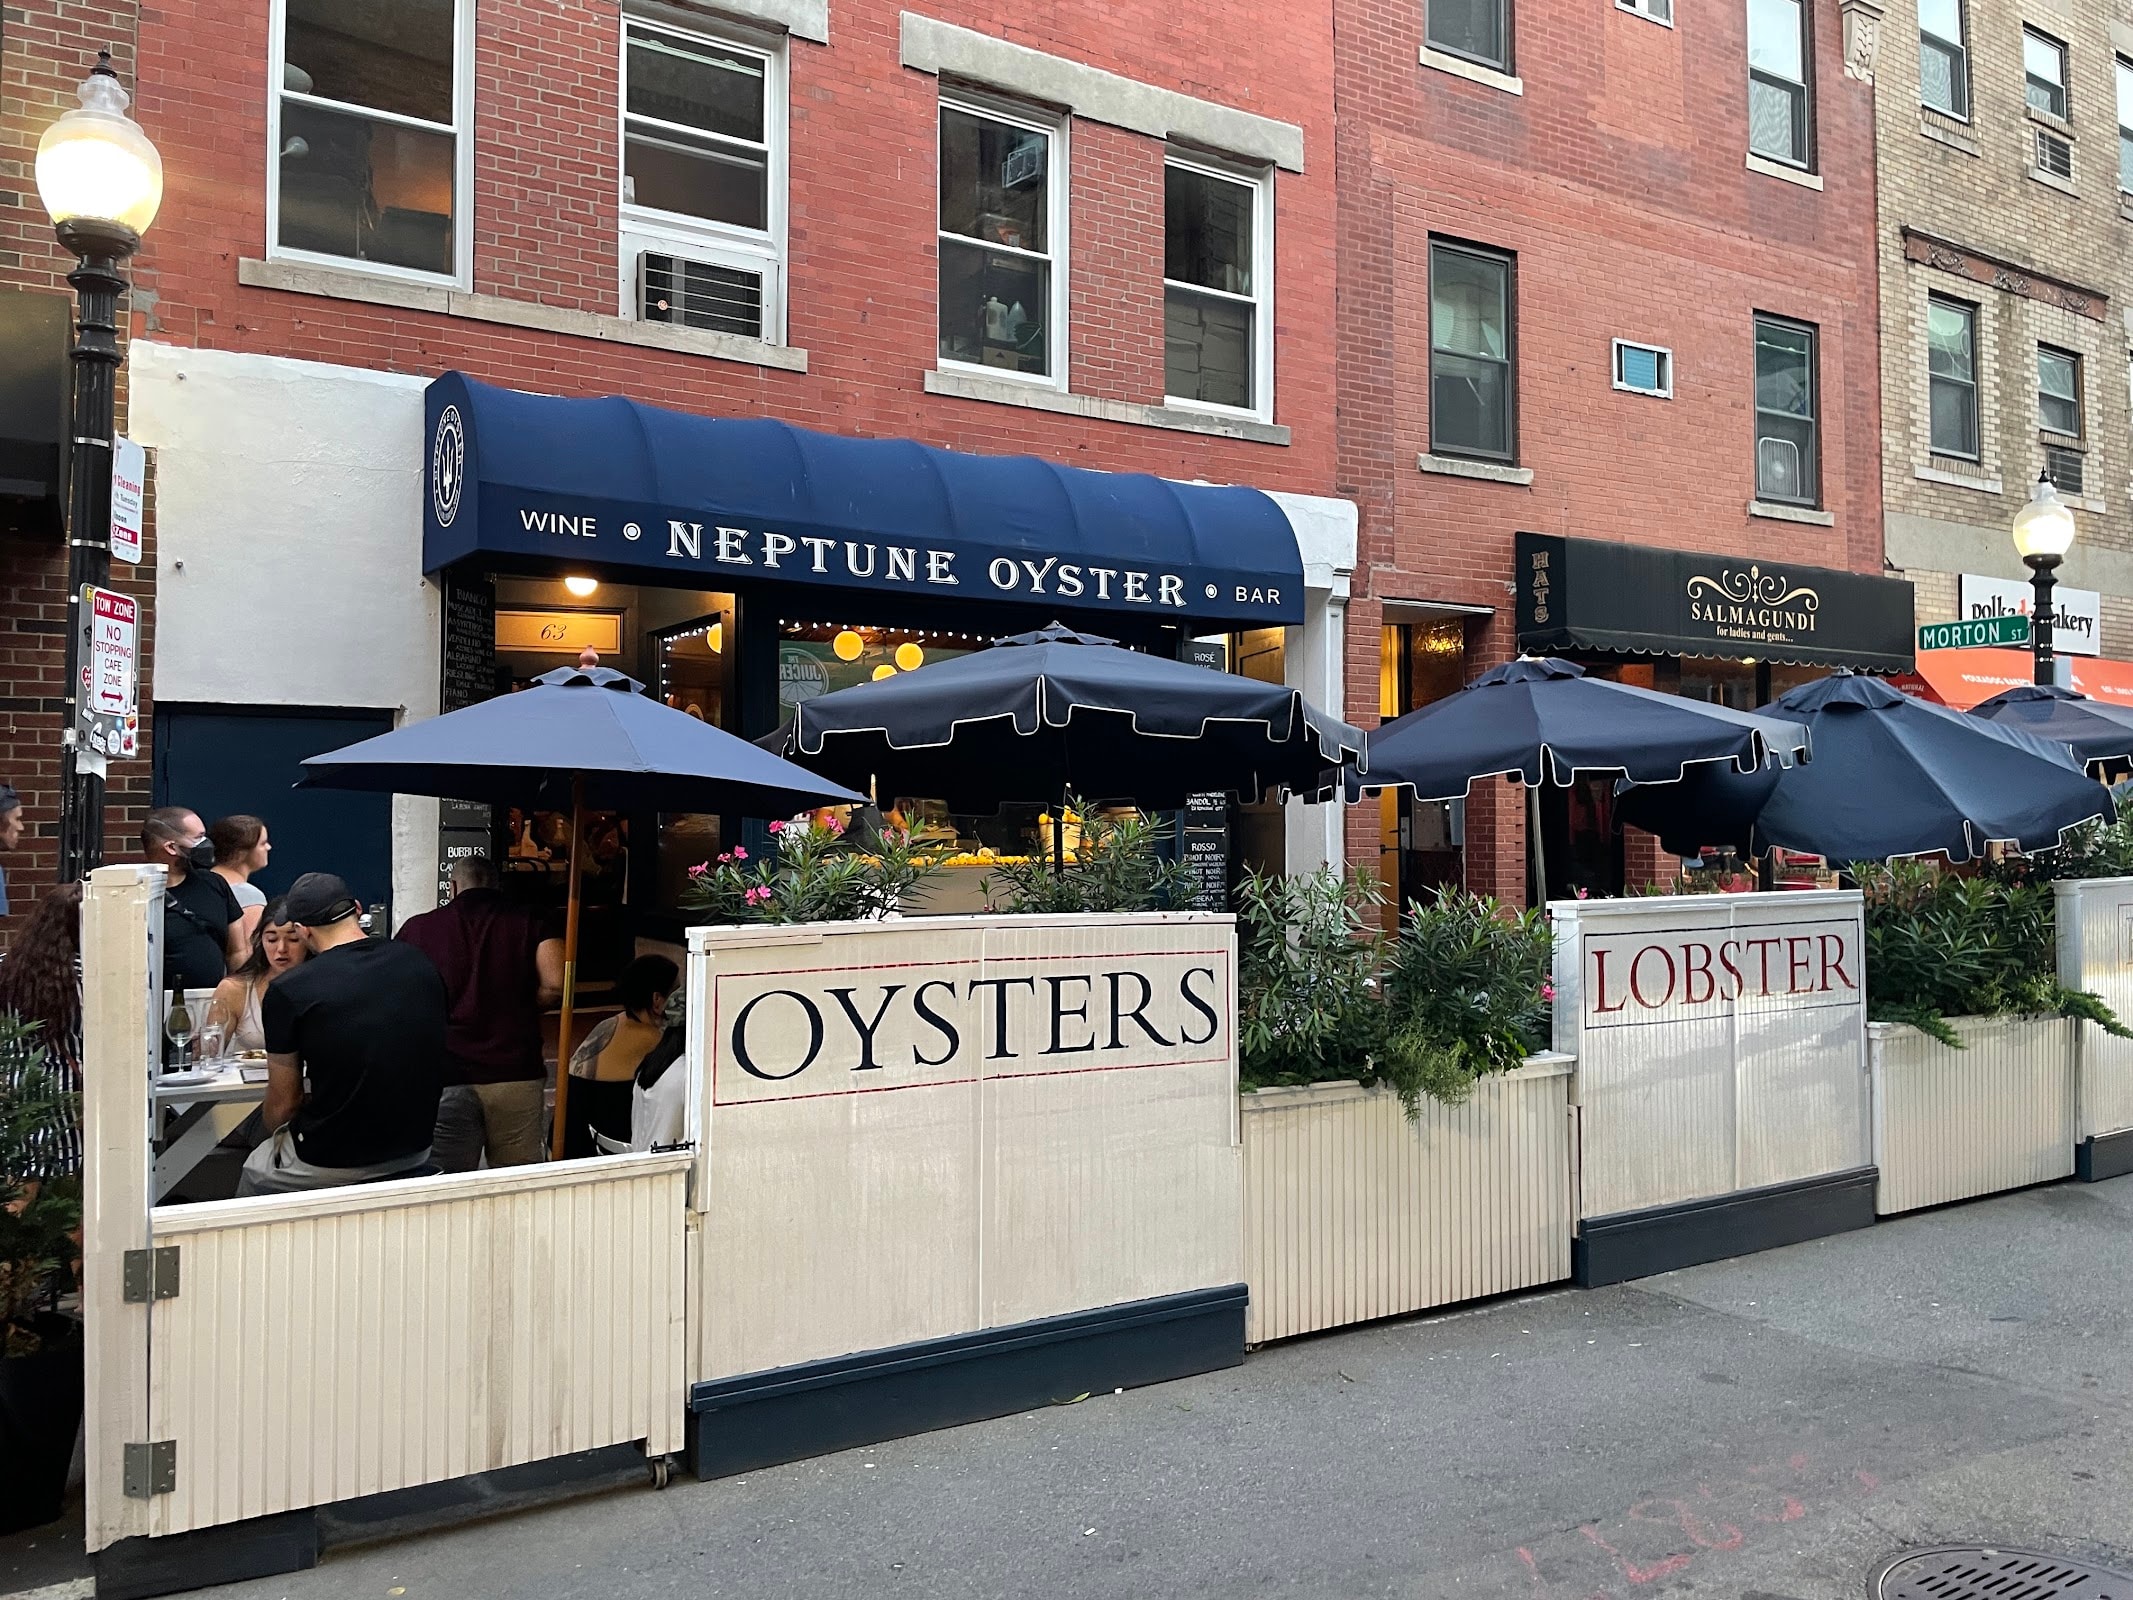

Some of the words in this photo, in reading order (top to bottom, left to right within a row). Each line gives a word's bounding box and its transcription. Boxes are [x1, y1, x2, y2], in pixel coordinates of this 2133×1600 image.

[118, 475, 141, 496] Cleaning
[120, 493, 138, 508] Tuesday
[520, 509, 598, 538] WINE
[665, 519, 960, 585] NEPTUNE
[988, 556, 1187, 608] OYSTER
[1235, 586, 1281, 605] BAR
[1531, 551, 1550, 624] HATS
[95, 596, 112, 613] TOW
[113, 601, 134, 619] ZONE
[1691, 602, 1816, 631] SALMAGUNDI
[2052, 604, 2093, 638] akery
[106, 624, 122, 641] NO
[540, 623, 567, 641] 63
[1716, 625, 1729, 637] for
[1729, 626, 1751, 639] ladies
[1752, 629, 1766, 640] and
[1767, 632, 1794, 643] gents...
[1923, 621, 2000, 649] MORTON
[2011, 628, 2022, 641] ST
[95, 640, 132, 659] STOPPING
[1194, 652, 1216, 663] ROSÉ
[104, 658, 122, 672] CAFE
[103, 673, 122, 687] ZONE
[447, 846, 486, 859] BUBBLES
[1191, 843, 1217, 852] ROSSO
[1592, 934, 1858, 1013] LOBSTER
[731, 968, 1219, 1081] OYSTERS
